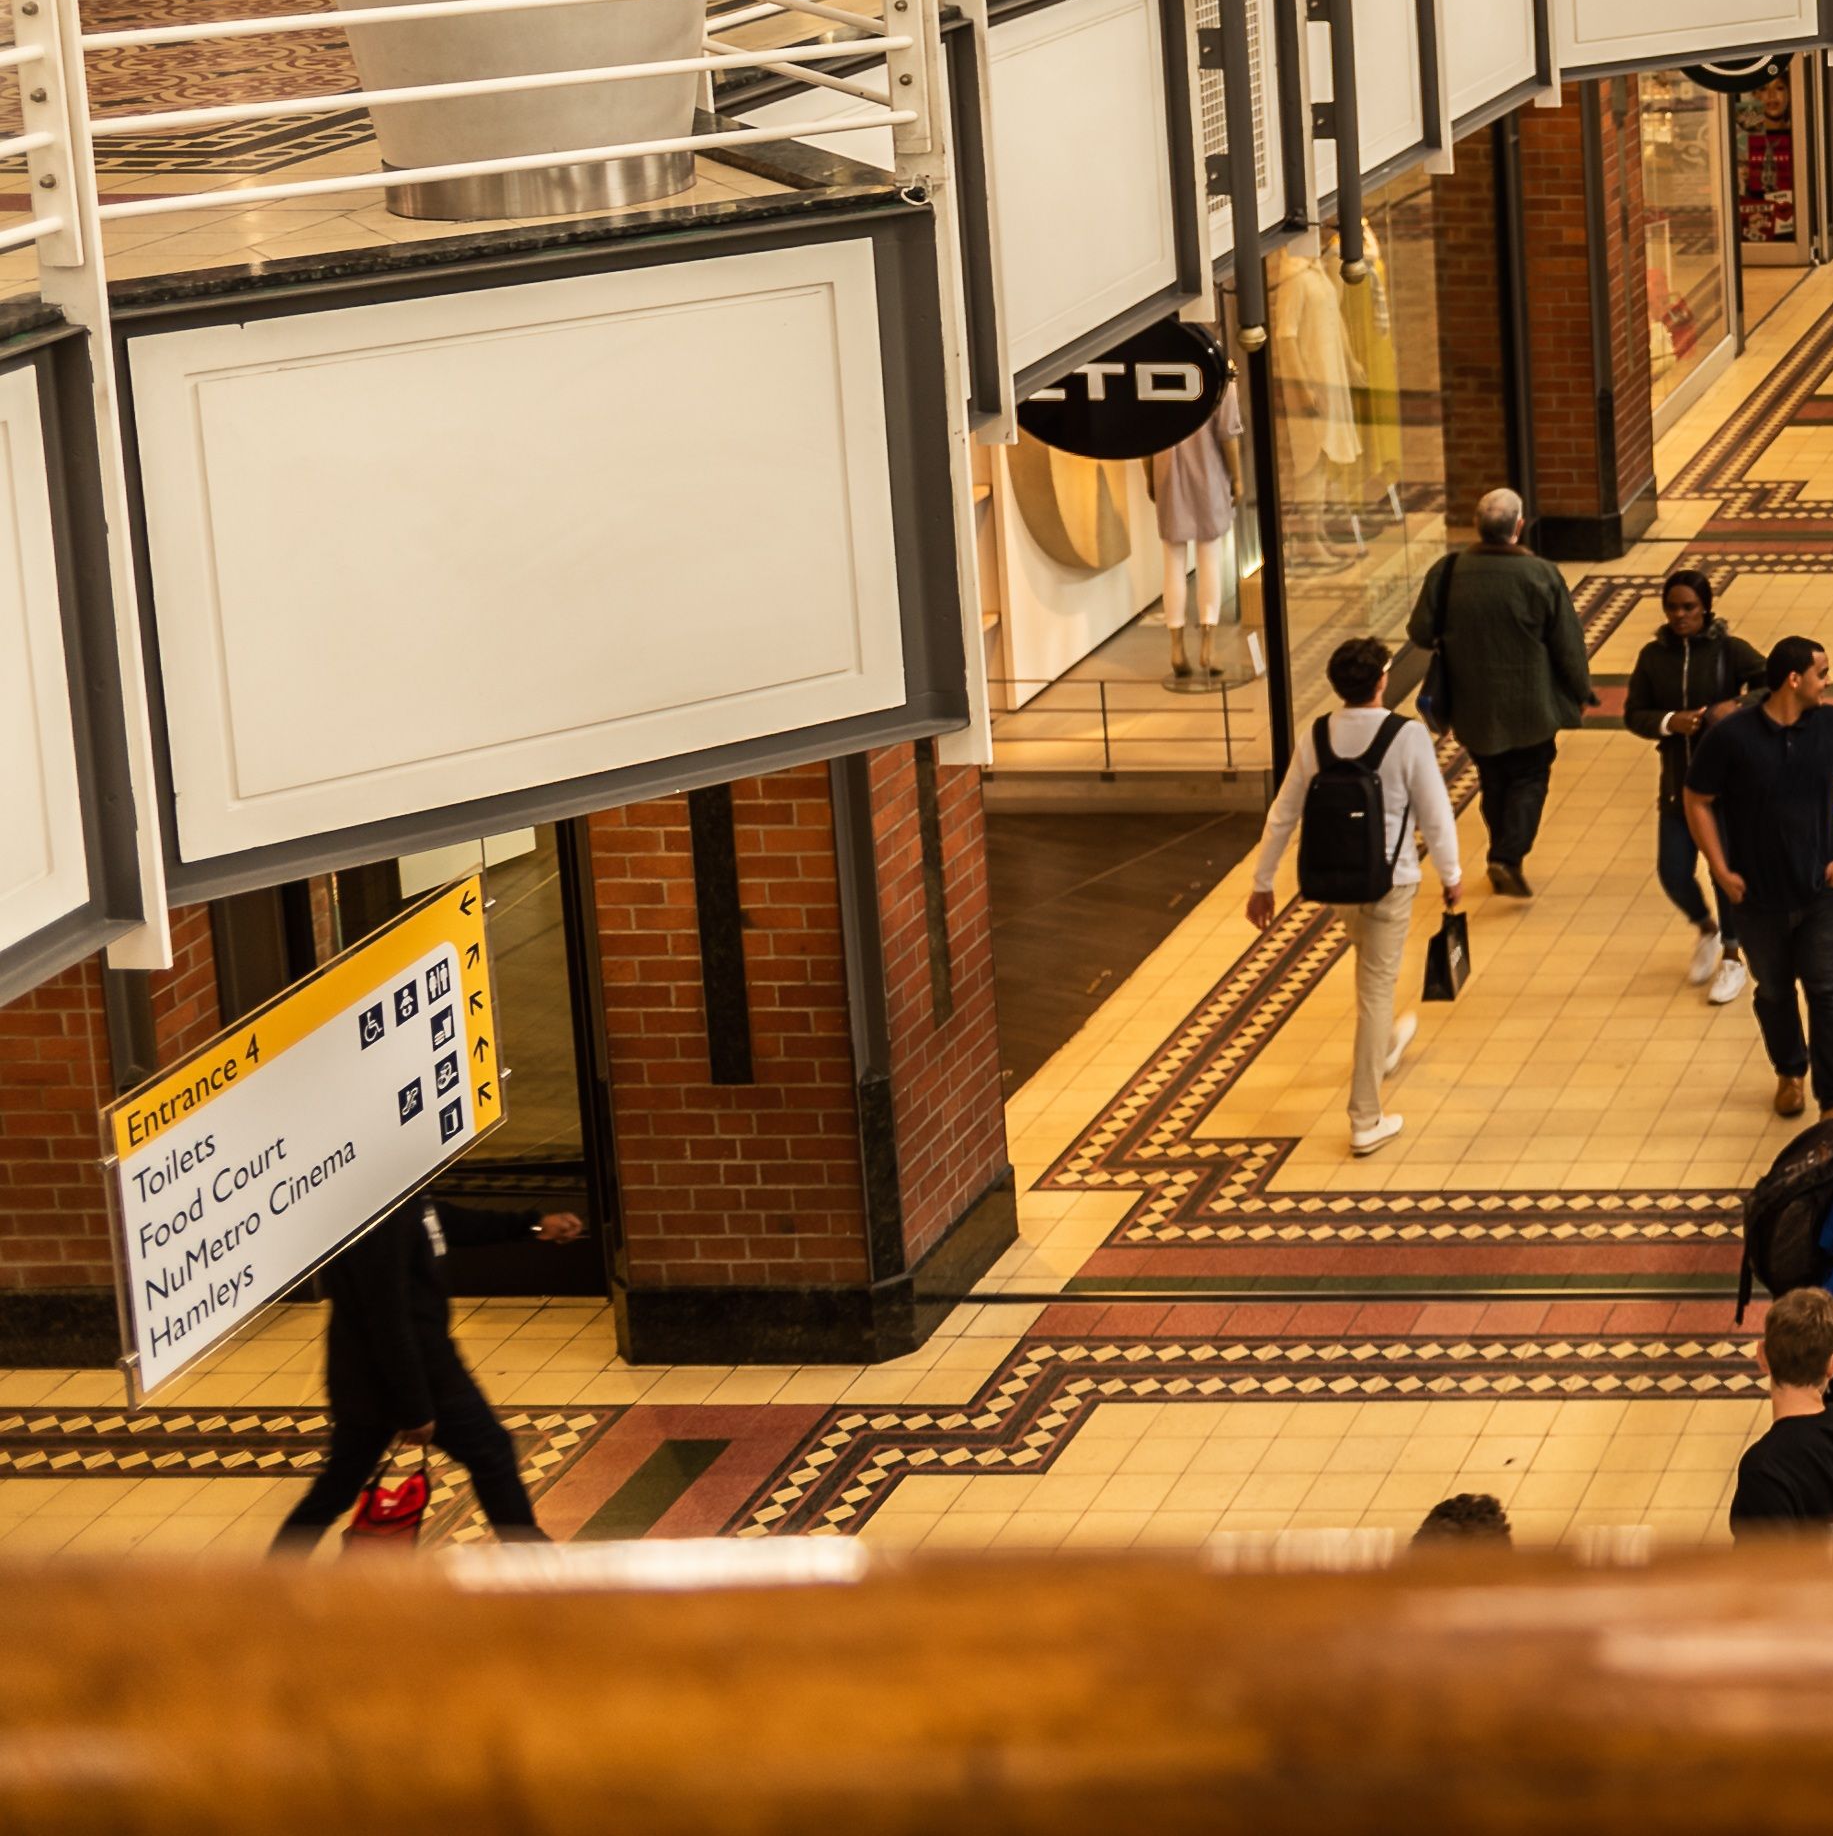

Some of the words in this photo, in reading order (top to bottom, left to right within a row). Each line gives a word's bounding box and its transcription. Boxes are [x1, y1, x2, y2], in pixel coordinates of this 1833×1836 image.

[127, 1058, 238, 1148] Entrance
[245, 1033, 260, 1063] 4
[132, 1134, 216, 1203] Toilets
[140, 1188, 202, 1259] Food
[212, 1137, 287, 1203] Court
[145, 1211, 261, 1311] NuMetro
[269, 1141, 357, 1216] Cinema
[150, 1264, 254, 1358] Hamleys
